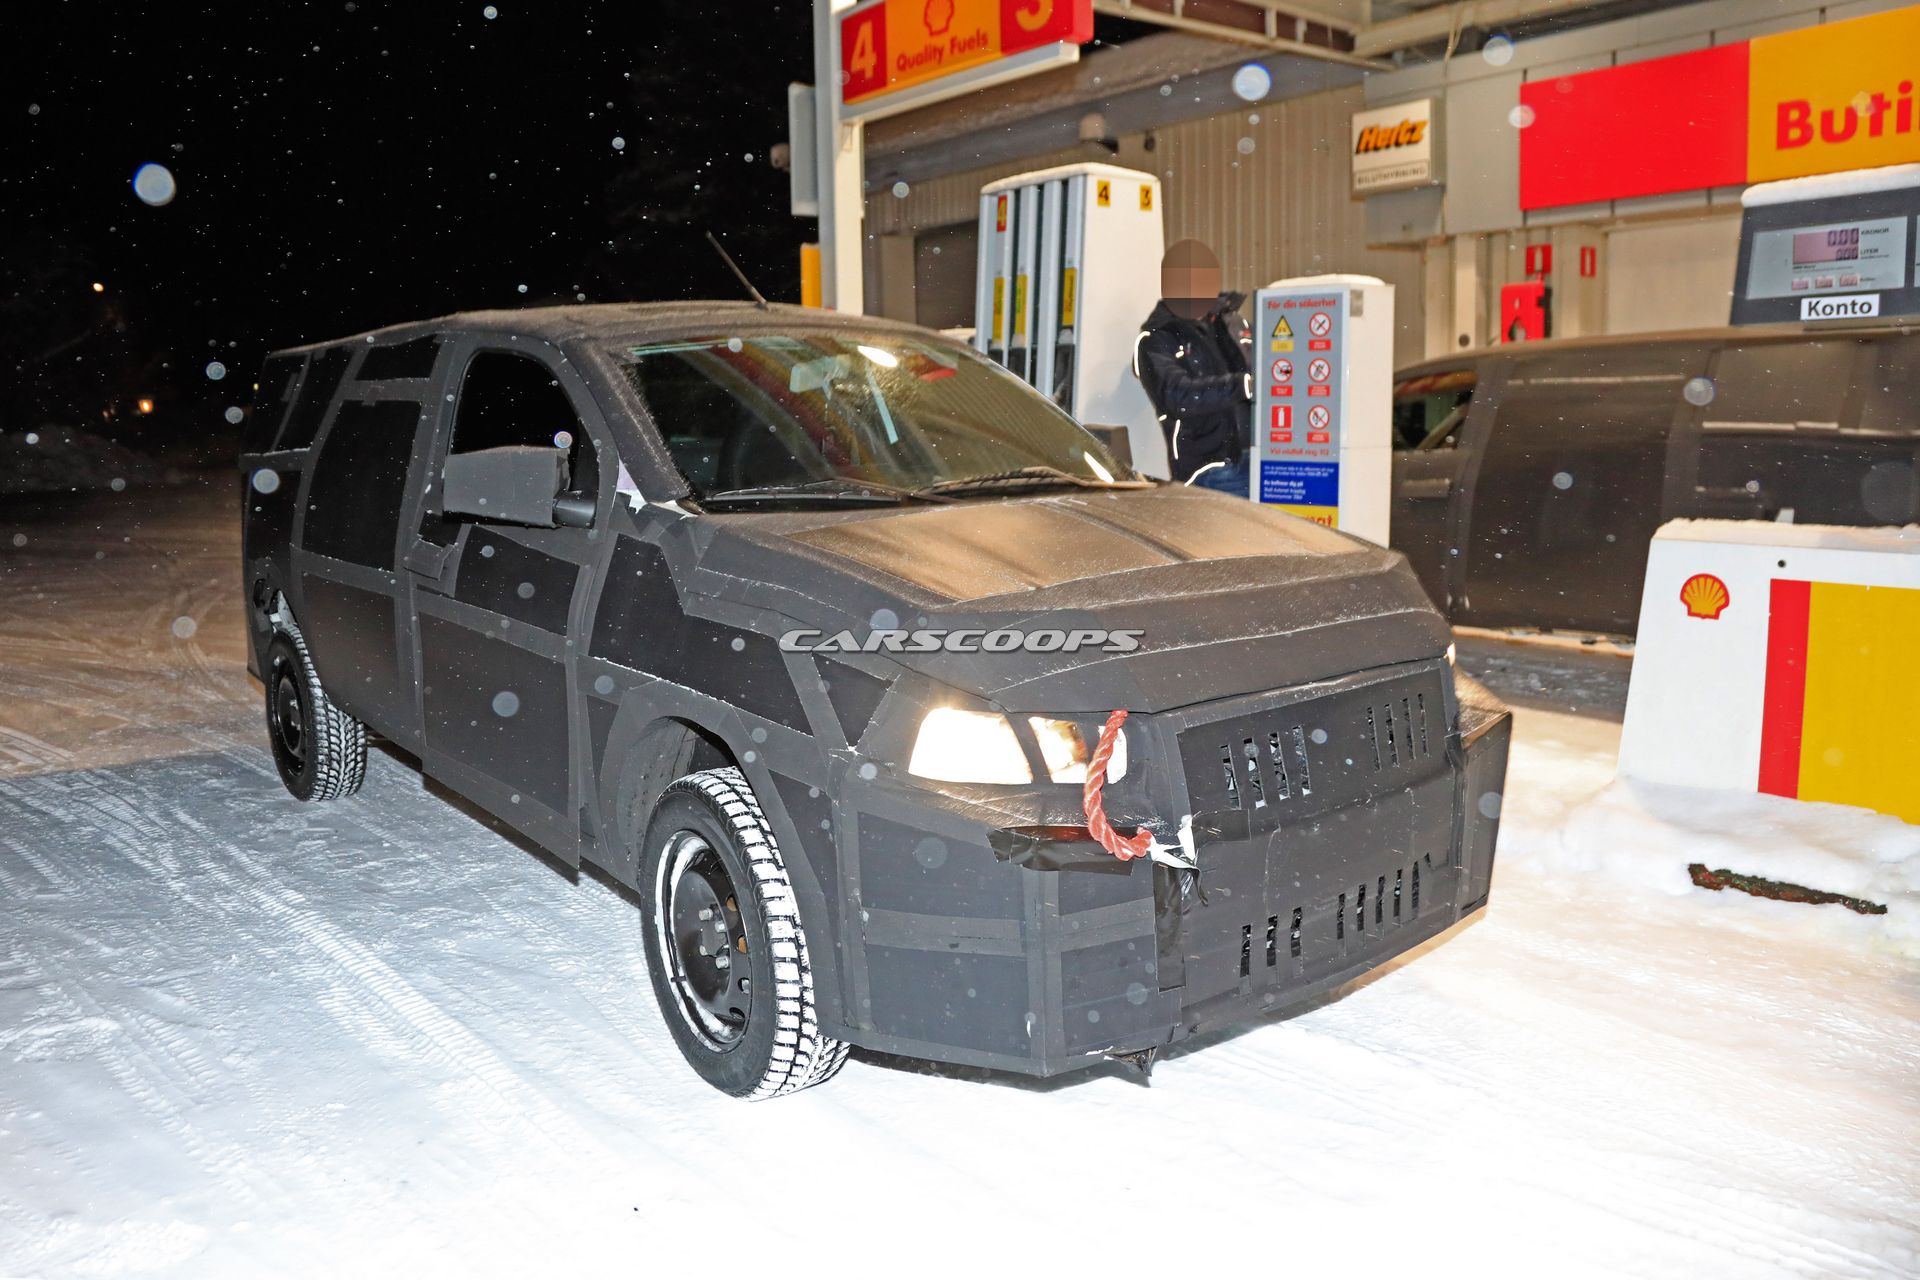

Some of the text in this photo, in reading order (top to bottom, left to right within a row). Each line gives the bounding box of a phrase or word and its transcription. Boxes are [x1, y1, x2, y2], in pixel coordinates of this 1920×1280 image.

[851, 20, 877, 80] 4
[896, 28, 989, 72] Quality Fuels
[1776, 79, 1920, 151] Buti
[1356, 118, 1428, 154] Hertz
[1098, 184, 1110, 202] 4
[1808, 299, 1873, 317] Konto
